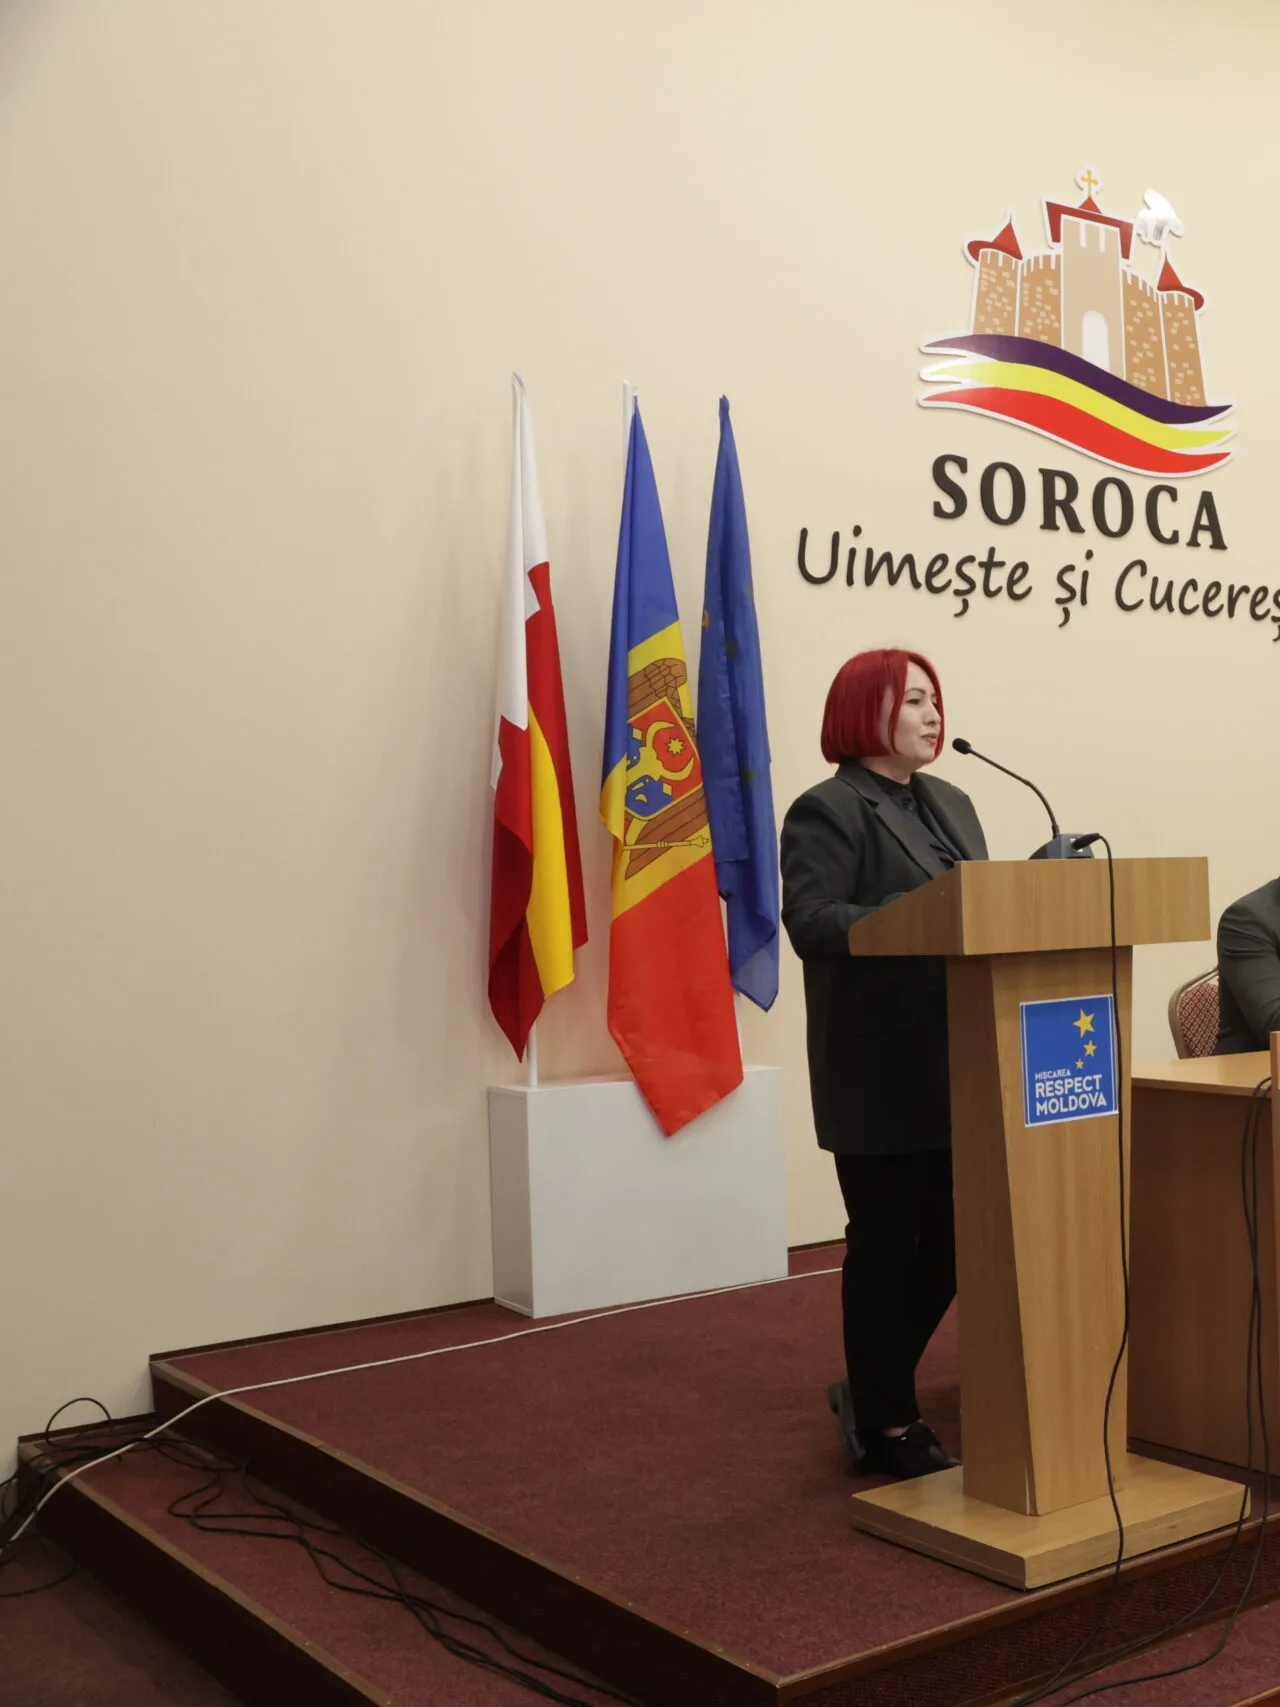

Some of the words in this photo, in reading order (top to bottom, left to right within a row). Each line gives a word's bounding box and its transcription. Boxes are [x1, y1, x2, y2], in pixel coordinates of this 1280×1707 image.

[932, 453, 1228, 551] SOROCA
[797, 524, 1033, 618] Uimește
[1054, 549, 1094, 628] și
[1035, 1074, 1102, 1098] RESPECT
[1036, 1091, 1107, 1116] MOLDOVA
